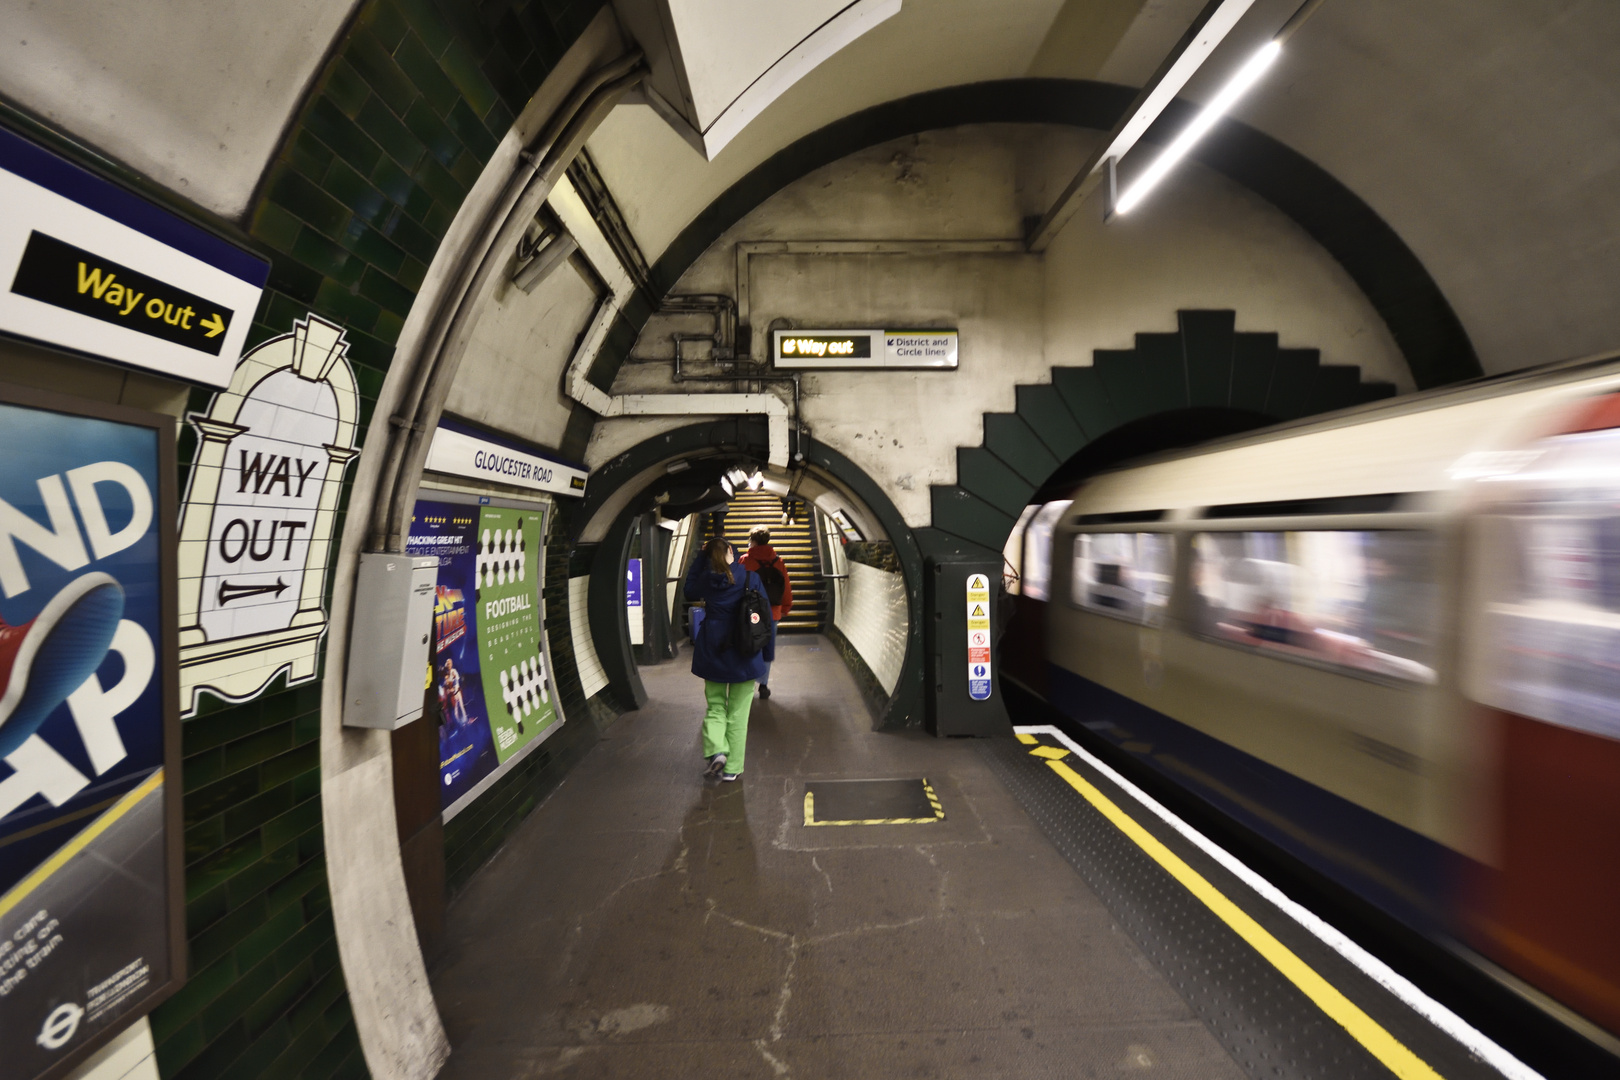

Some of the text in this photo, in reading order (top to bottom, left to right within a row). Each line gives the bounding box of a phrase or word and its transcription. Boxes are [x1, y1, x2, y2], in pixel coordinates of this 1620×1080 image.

[77, 261, 196, 330] Way out
[797, 338, 854, 356] Way out
[896, 338, 948, 346] District and
[896, 348, 946, 356] Circle lines
[236, 449, 319, 498] WAY
[474, 450, 553, 483] GLOUCESTER ROAD
[219, 518, 307, 563] OUT
[486, 593, 531, 620] FOOTBALL
[487, 613, 532, 634] DESIGNING THE
[488, 626, 533, 648] BEAUTIFUL
